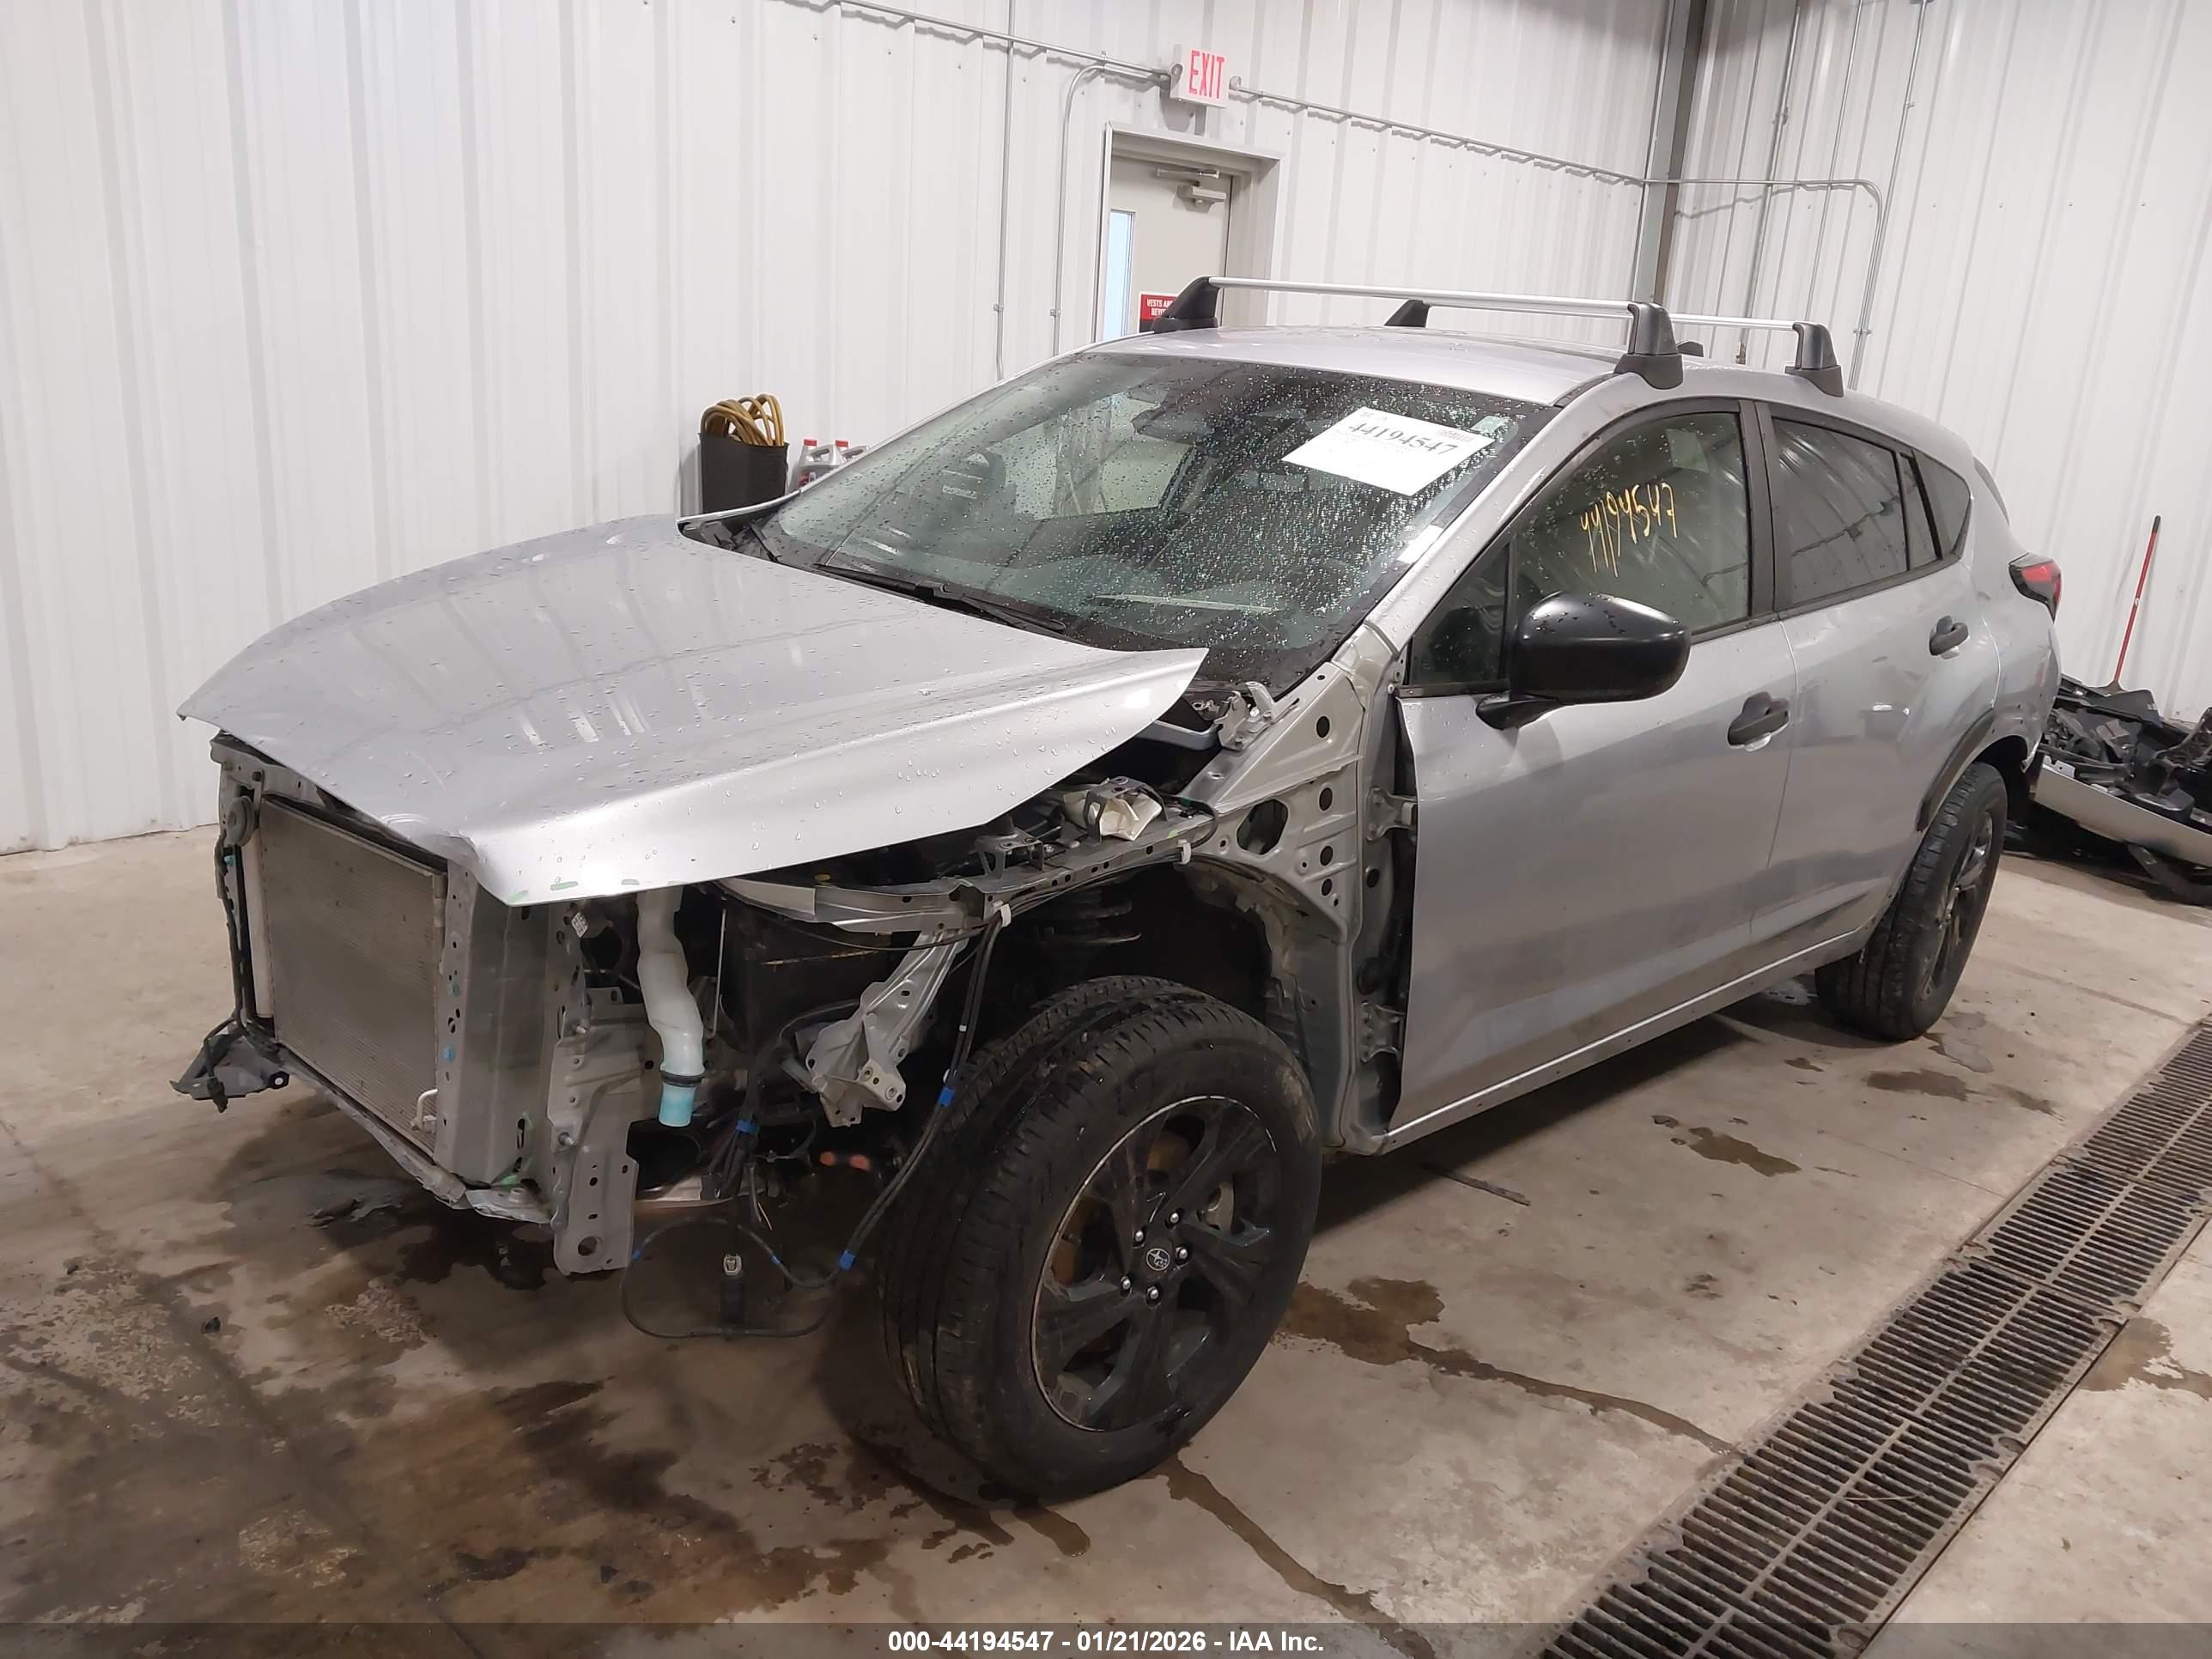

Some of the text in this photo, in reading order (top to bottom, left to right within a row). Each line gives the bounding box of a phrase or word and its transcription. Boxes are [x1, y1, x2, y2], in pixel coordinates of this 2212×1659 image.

[1188, 50, 1224, 99] EXIT
[1146, 298, 1163, 308] VESTS
[1348, 422, 1459, 455] 44194547
[1580, 482, 1677, 578] 44194547
